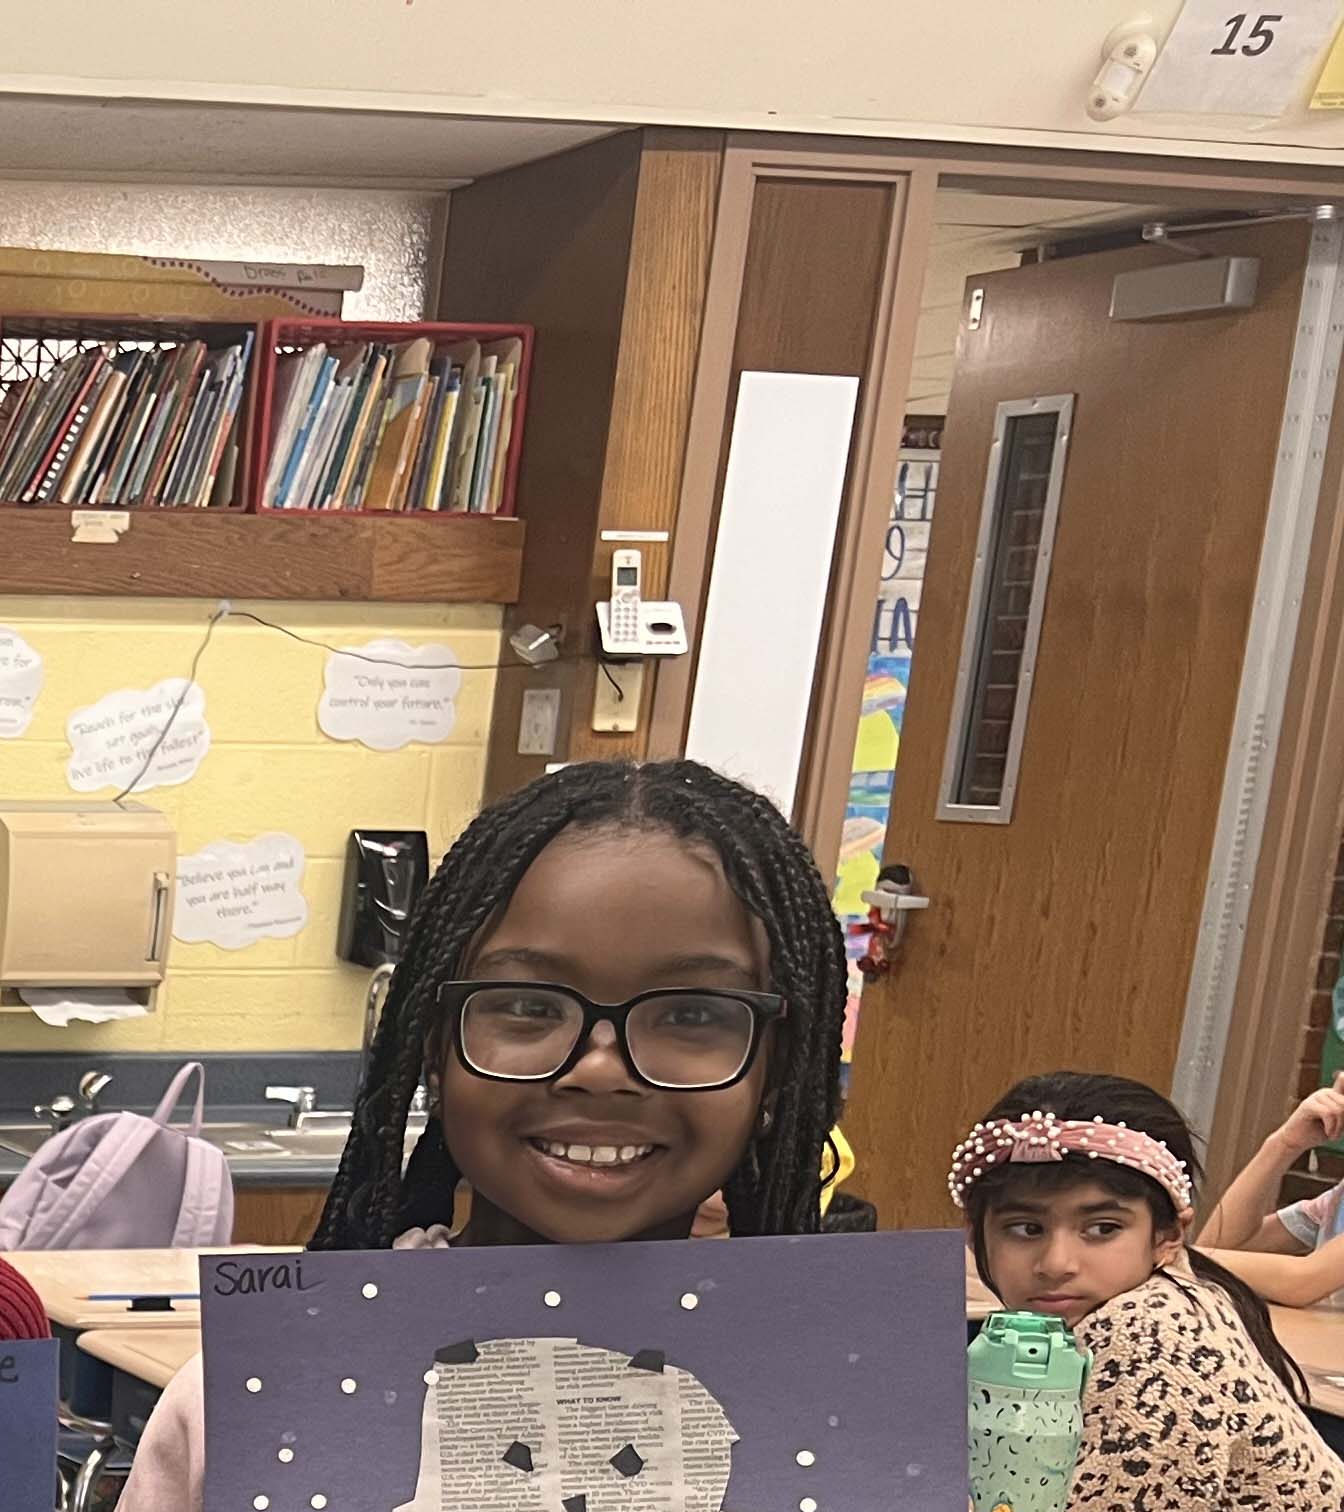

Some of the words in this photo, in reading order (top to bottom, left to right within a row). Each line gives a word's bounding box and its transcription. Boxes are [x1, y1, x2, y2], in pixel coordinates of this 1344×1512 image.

[1210, 13, 1283, 57] 15
[227, 868, 247, 880] you
[273, 856, 294, 871] and
[185, 895, 207, 908] you
[232, 882, 259, 899] half
[214, 1259, 328, 1297] Sarai
